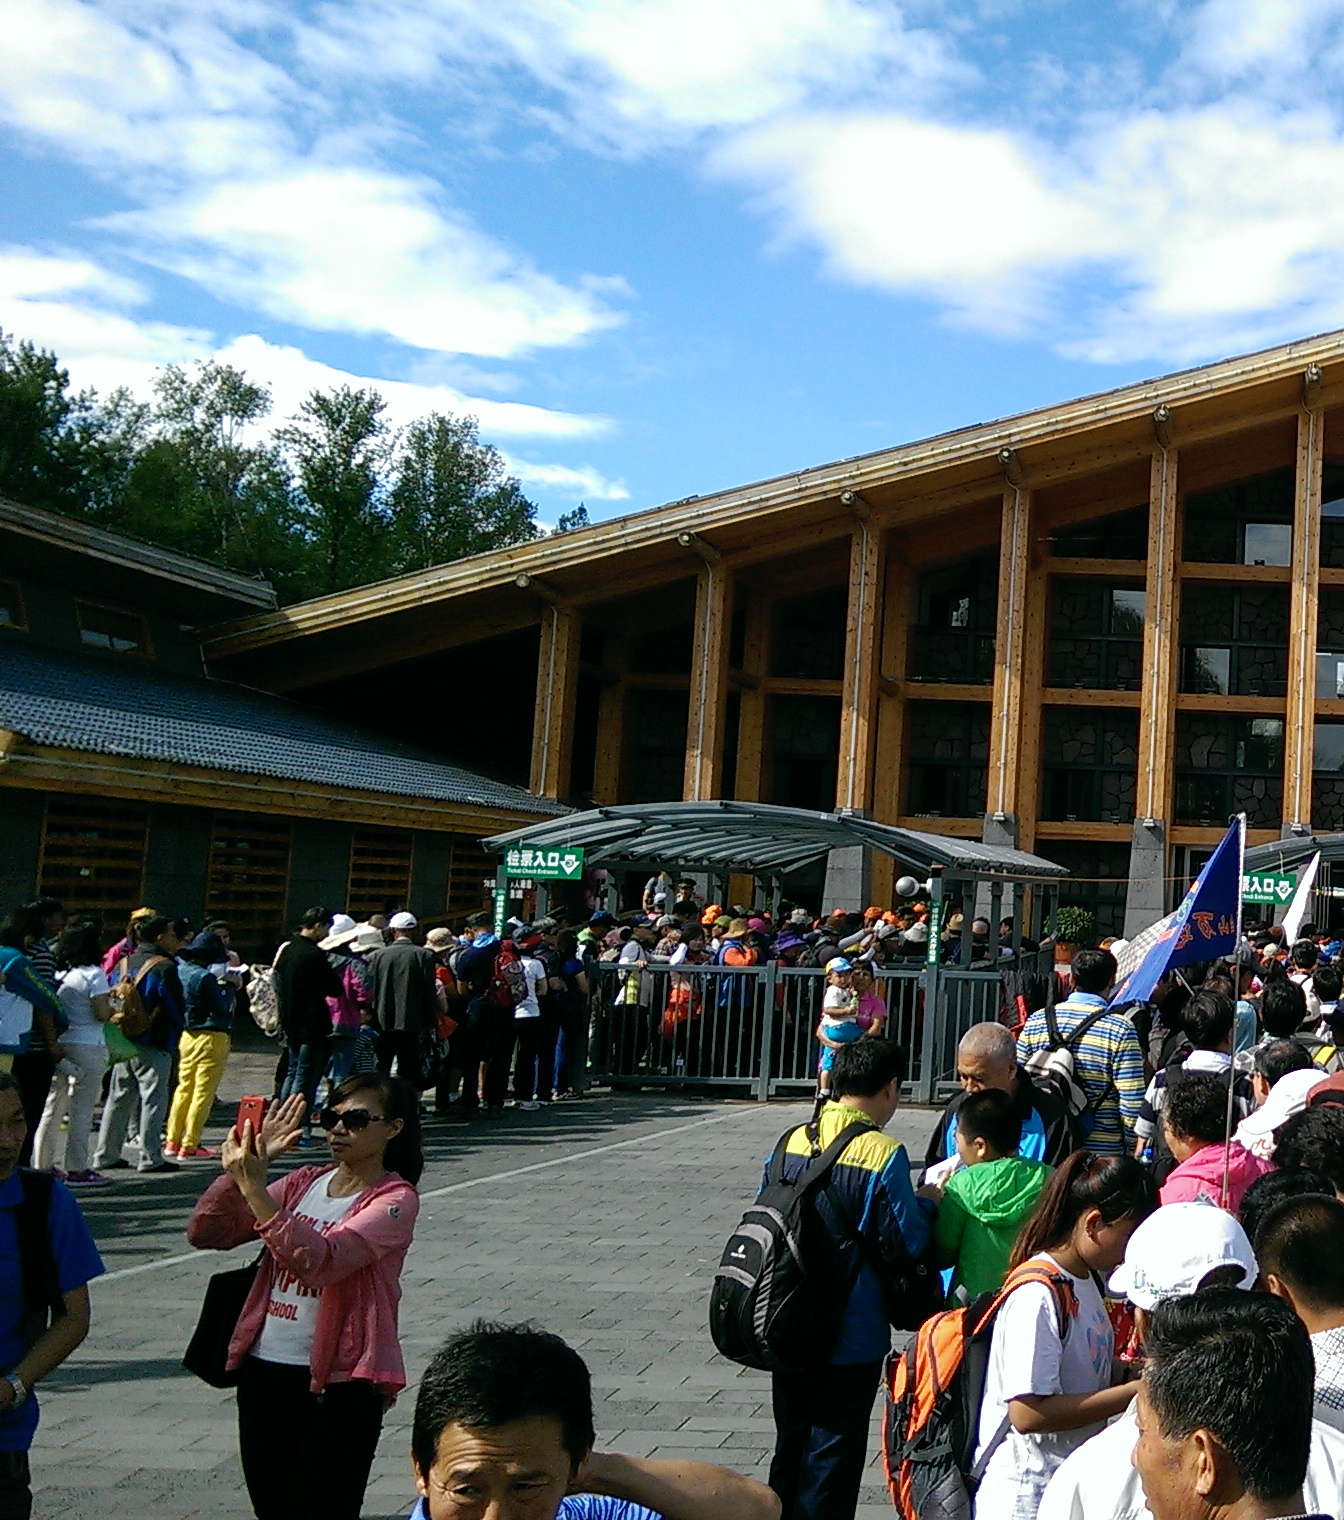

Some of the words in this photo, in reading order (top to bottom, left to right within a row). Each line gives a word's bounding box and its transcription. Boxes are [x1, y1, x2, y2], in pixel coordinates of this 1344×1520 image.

[506, 849, 560, 868] 检票入口
[1242, 875, 1275, 893] 票入口
